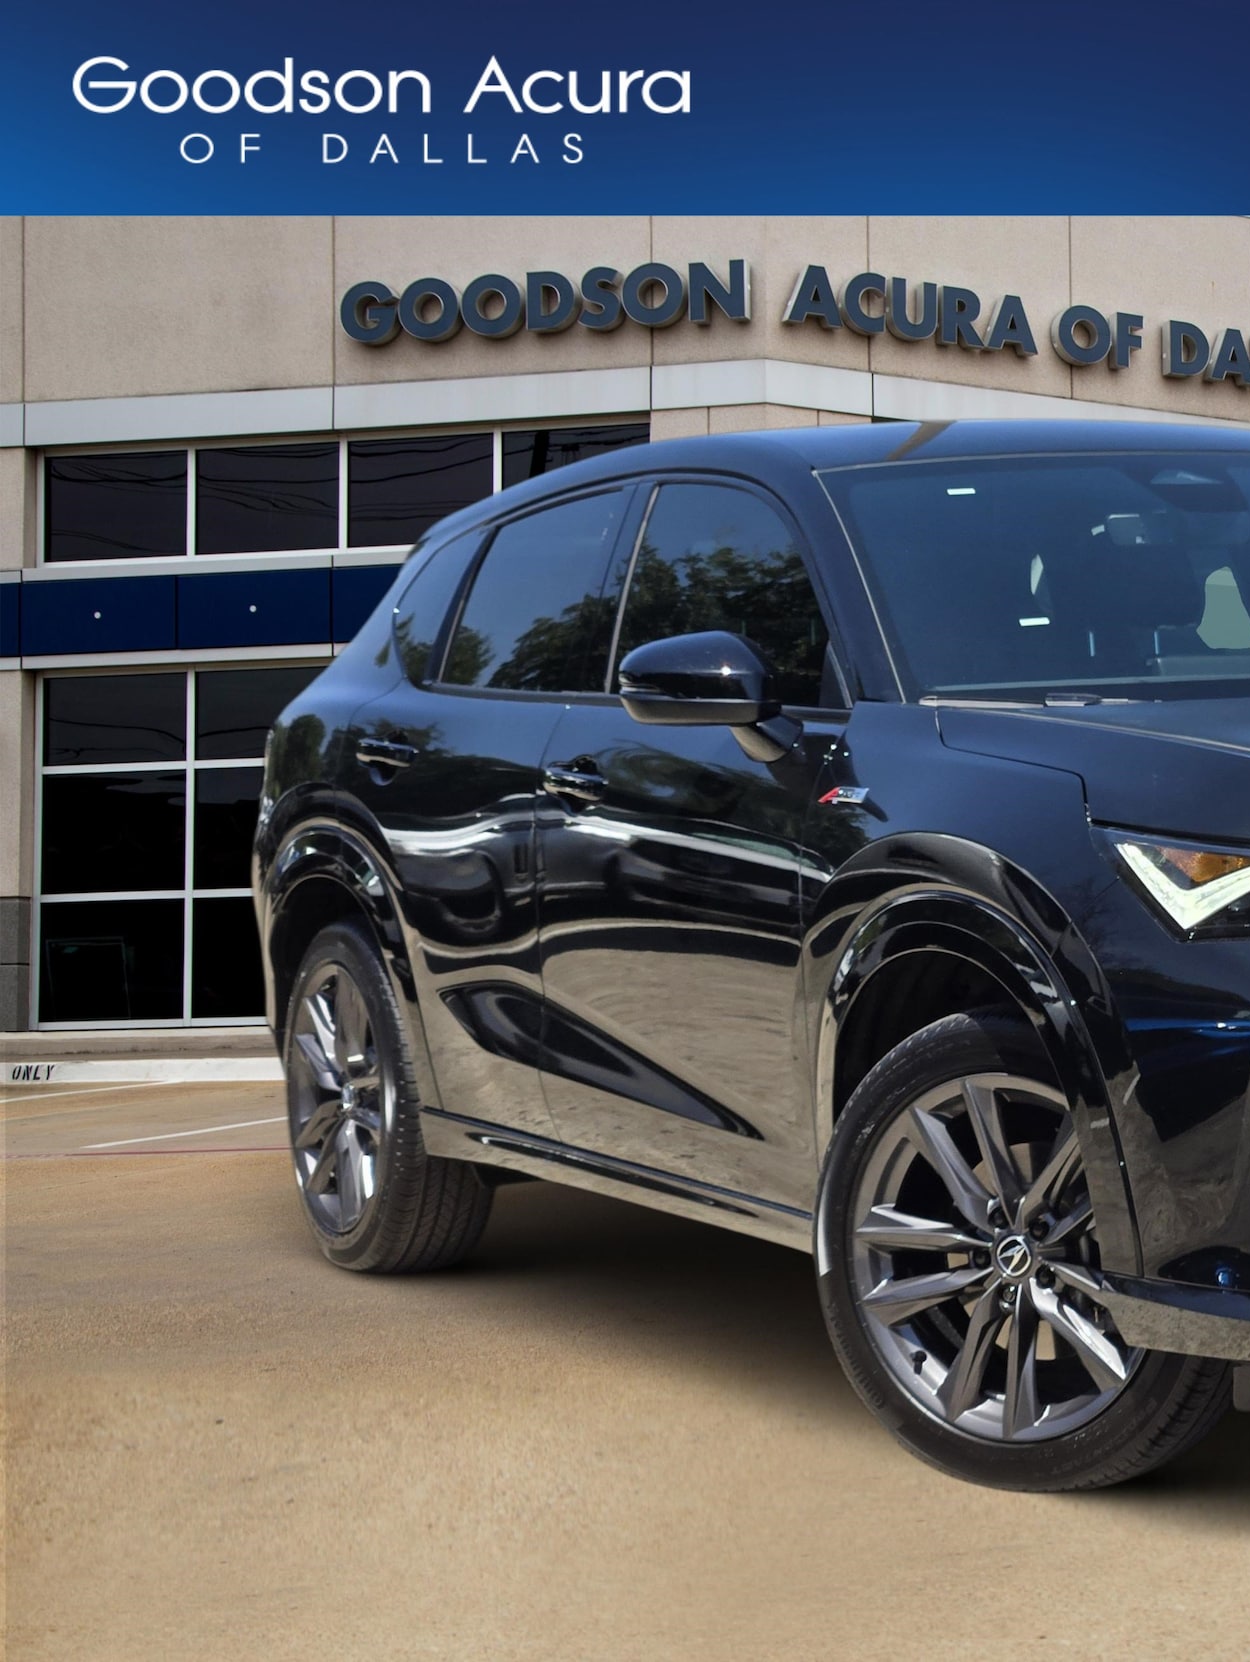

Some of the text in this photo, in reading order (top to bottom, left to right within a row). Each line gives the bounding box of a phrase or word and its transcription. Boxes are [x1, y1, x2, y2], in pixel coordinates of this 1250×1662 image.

[340, 259, 750, 345] GOODSON
[782, 264, 1038, 357] ACURA
[1052, 305, 1143, 369] OF
[12, 1065, 55, 1081] ONLY
